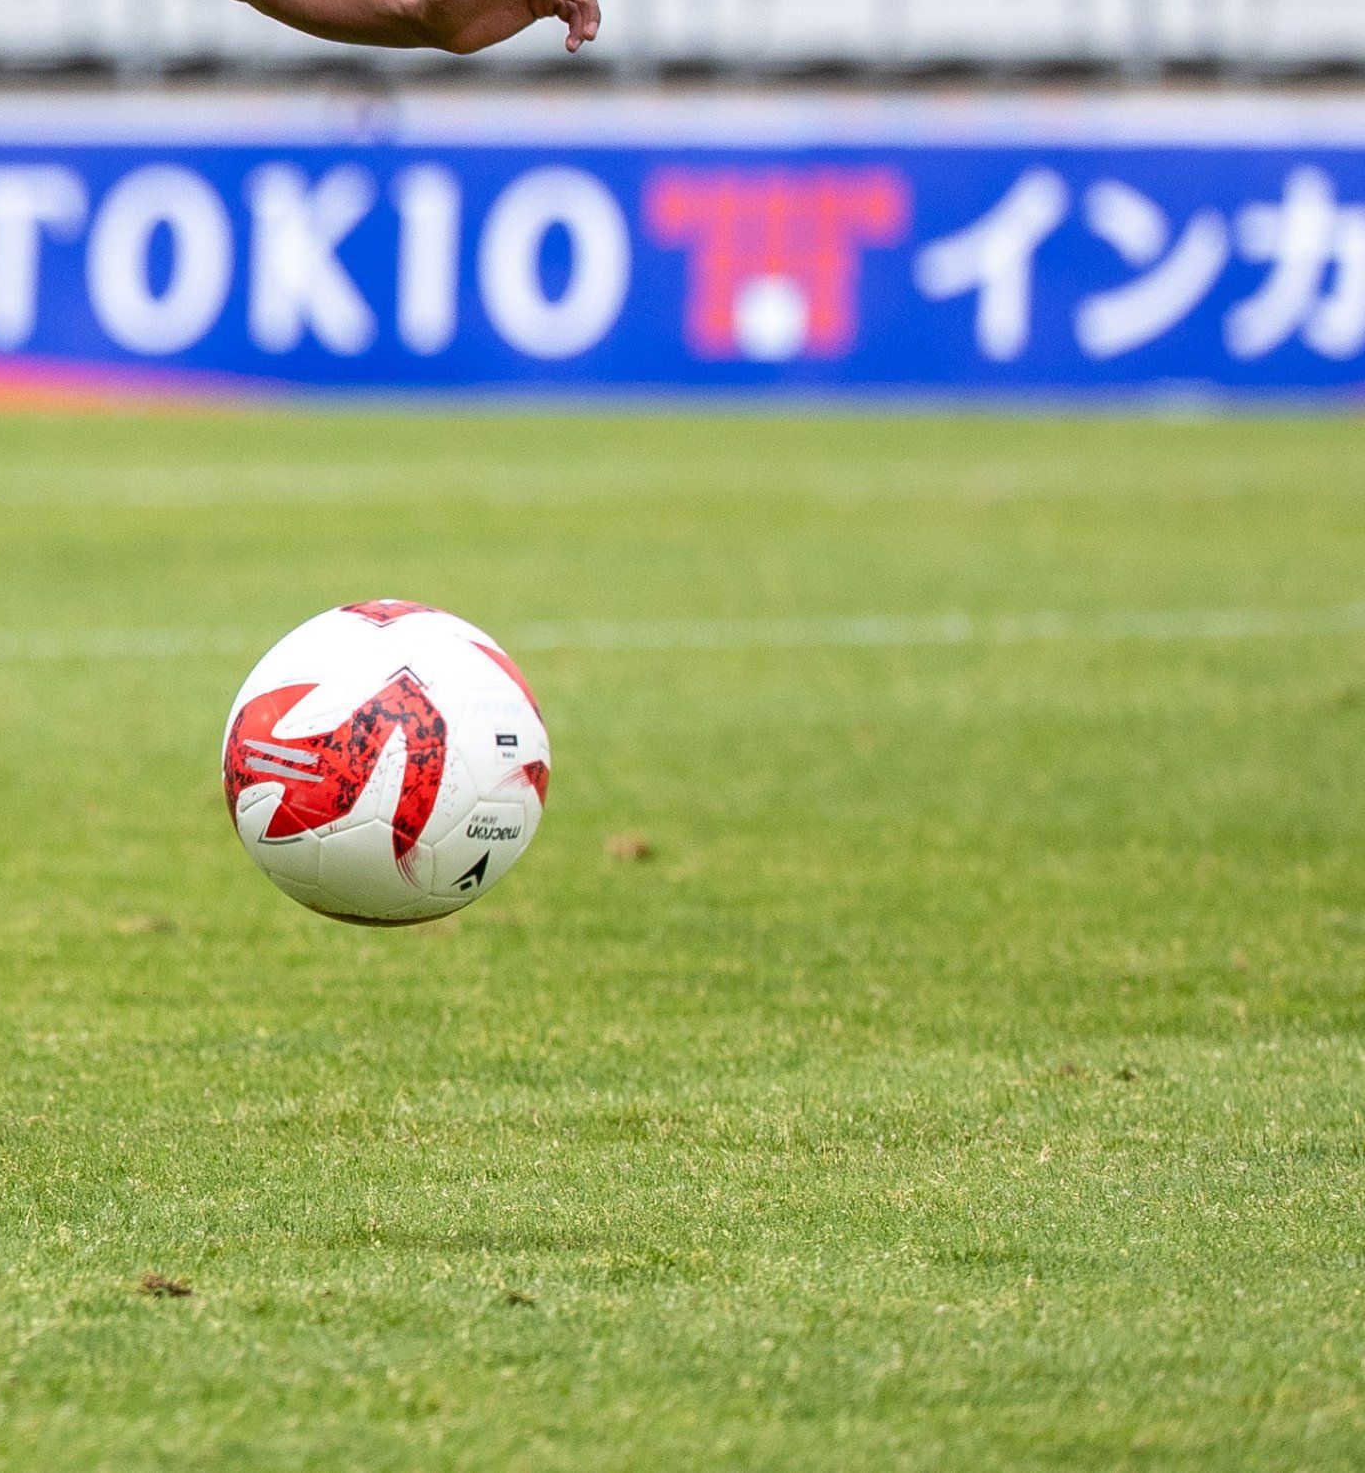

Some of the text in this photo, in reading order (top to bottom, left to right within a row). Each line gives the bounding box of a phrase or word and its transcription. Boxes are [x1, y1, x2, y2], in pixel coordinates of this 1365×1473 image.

[911, 163, 1365, 363] インカ
[466, 824, 521, 841] macron
